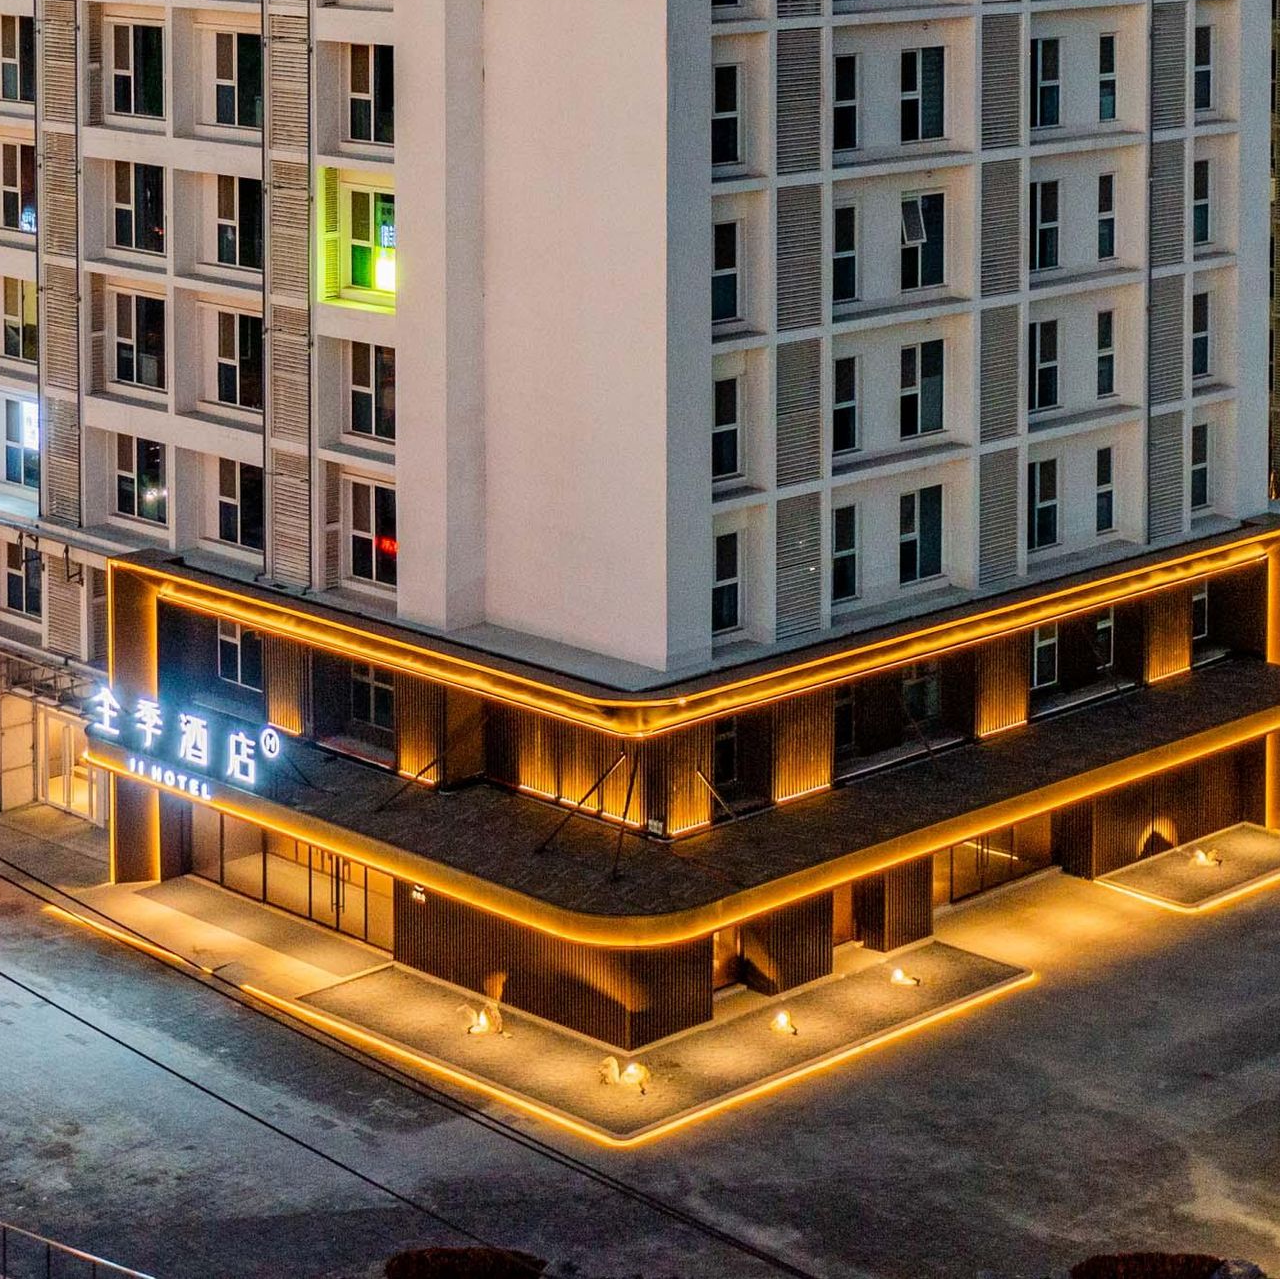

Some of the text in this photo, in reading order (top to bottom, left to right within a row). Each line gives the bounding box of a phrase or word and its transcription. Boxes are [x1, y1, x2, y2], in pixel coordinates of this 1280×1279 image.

[91, 687, 256, 784] 全季酒店
[150, 765, 212, 800] HOTEL
